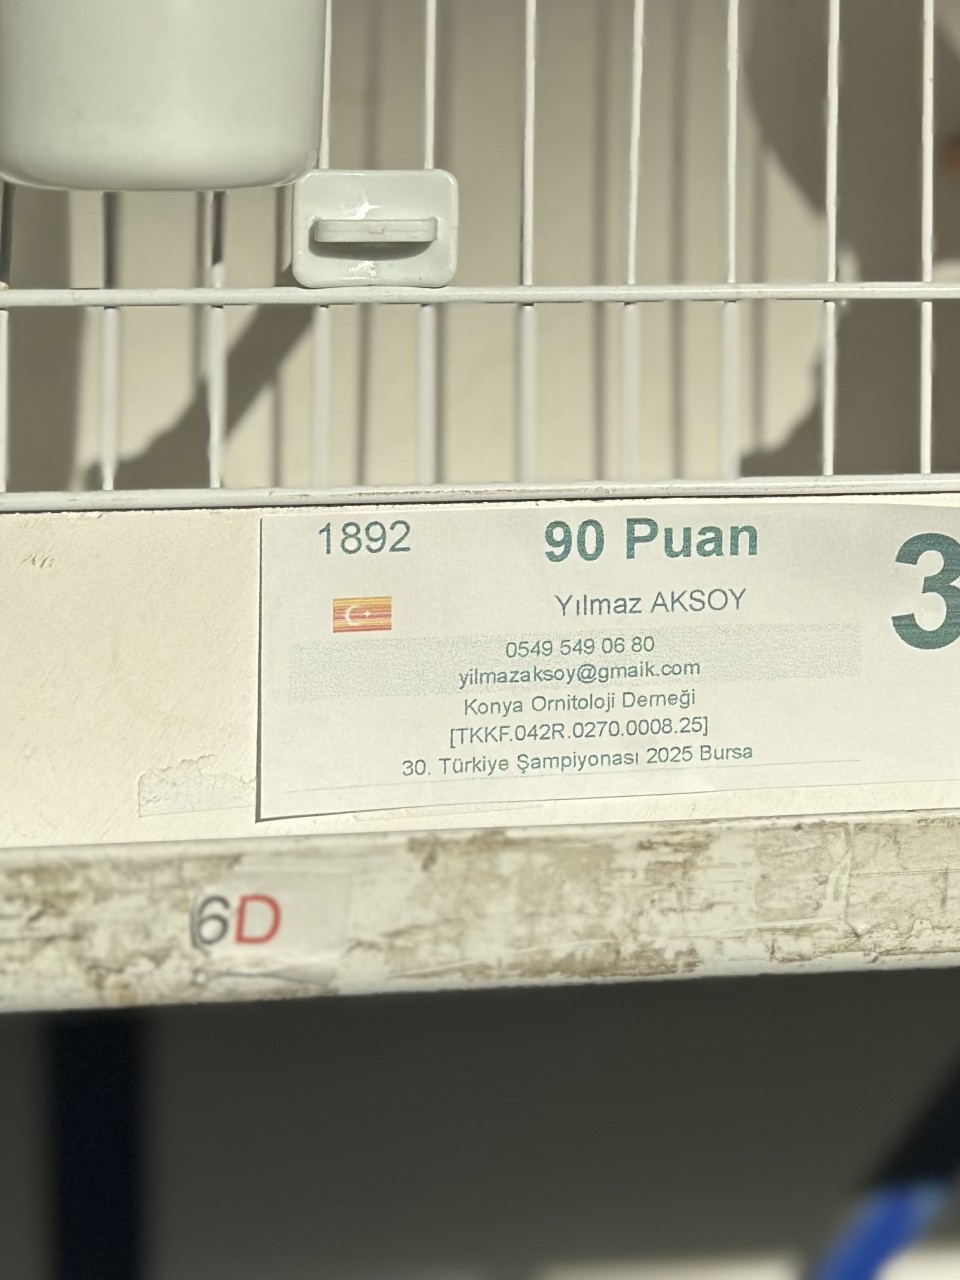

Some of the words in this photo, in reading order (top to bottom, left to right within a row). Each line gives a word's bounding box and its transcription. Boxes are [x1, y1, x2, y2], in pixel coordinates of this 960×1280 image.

[318, 520, 412, 555] 1892
[544, 519, 605, 563] 90
[626, 517, 758, 560] Puan
[554, 593, 642, 617] Yılmaz
[650, 588, 747, 613] AKSOY
[505, 640, 553, 658] 0549
[559, 637, 595, 656] 549
[601, 636, 626, 654] 06
[631, 635, 655, 653] 80
[458, 660, 701, 690] yilmazaksoy@gmaik.com
[464, 697, 524, 717] Konya
[531, 693, 616, 713] Ornitoloji
[622, 688, 697, 710] Derneği
[450, 716, 709, 749] [TKKF.042R.0270.0008.25]
[402, 760, 431, 777] 30.
[439, 756, 510, 777] Türkiye
[517, 751, 640, 774] Şampiyonası
[646, 746, 694, 765] 2025
[700, 743, 754, 762] Bursa
